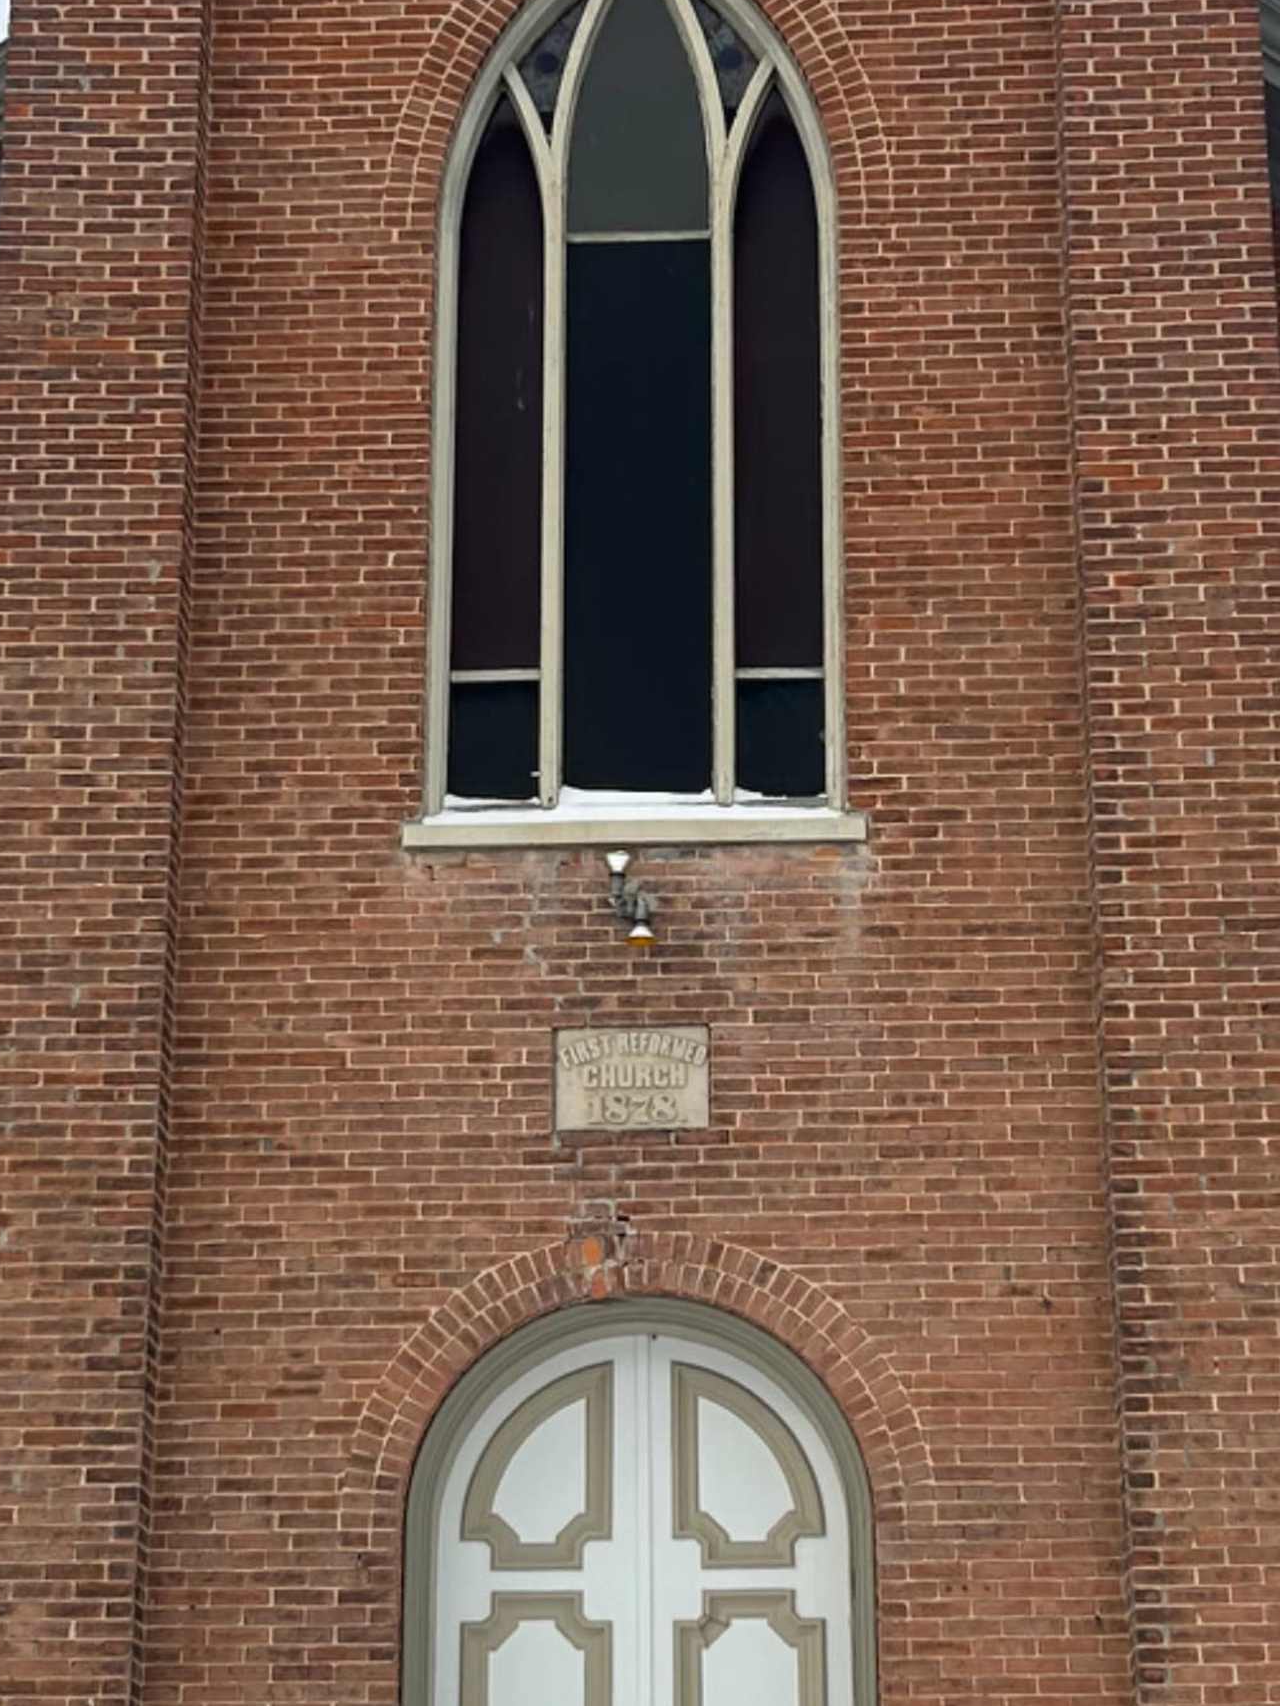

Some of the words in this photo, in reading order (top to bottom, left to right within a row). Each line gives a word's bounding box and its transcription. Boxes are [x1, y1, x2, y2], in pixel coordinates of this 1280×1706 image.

[559, 1034, 611, 1069] FIRST
[618, 1031, 708, 1066] REFORMED
[583, 1063, 687, 1088] CHURCH
